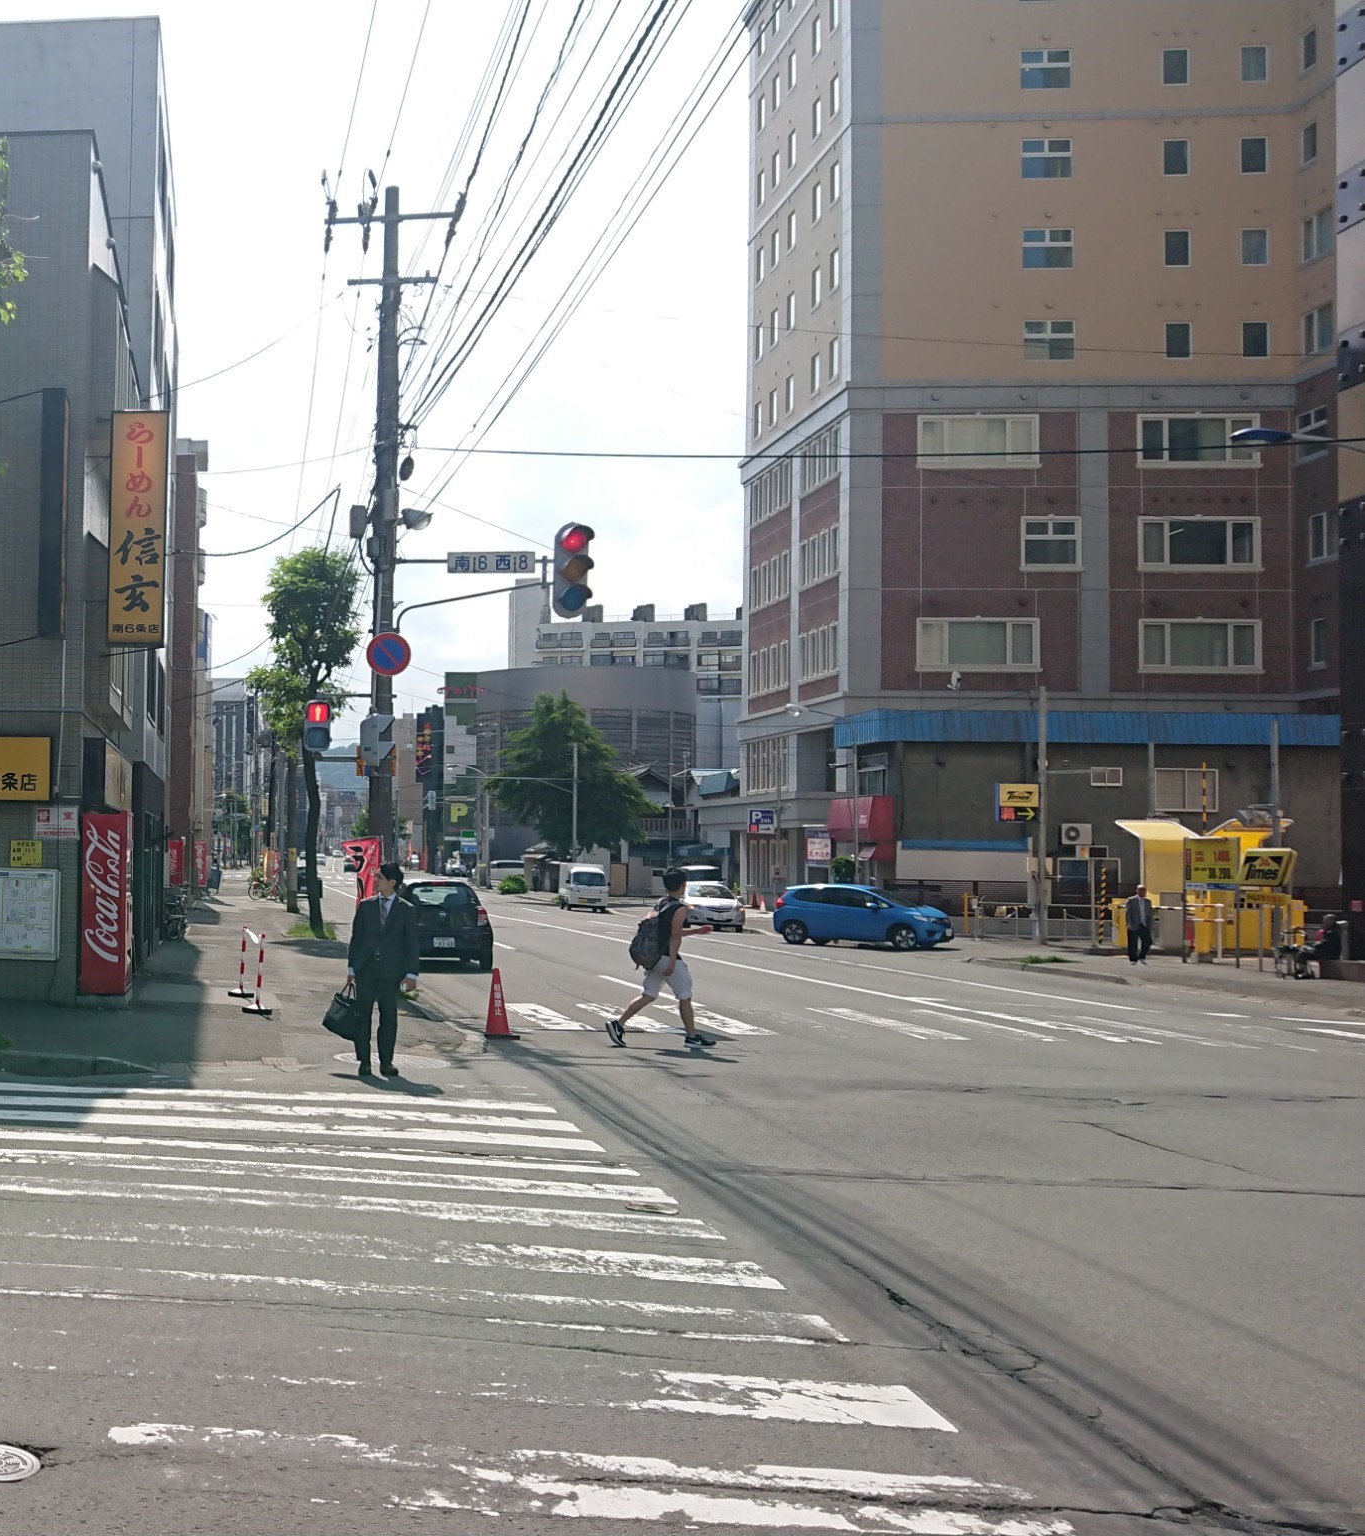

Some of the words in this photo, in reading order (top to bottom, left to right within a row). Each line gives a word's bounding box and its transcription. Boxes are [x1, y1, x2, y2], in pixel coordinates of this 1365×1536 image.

[125, 421, 155, 519] らーめん
[113, 527, 162, 613] 信玄
[112, 623, 160, 634] 南6条店
[450, 803, 468, 823] P
[752, 811, 762, 823] P
[1244, 862, 1280, 881] Times
[85, 820, 121, 963] Coca-Cola
